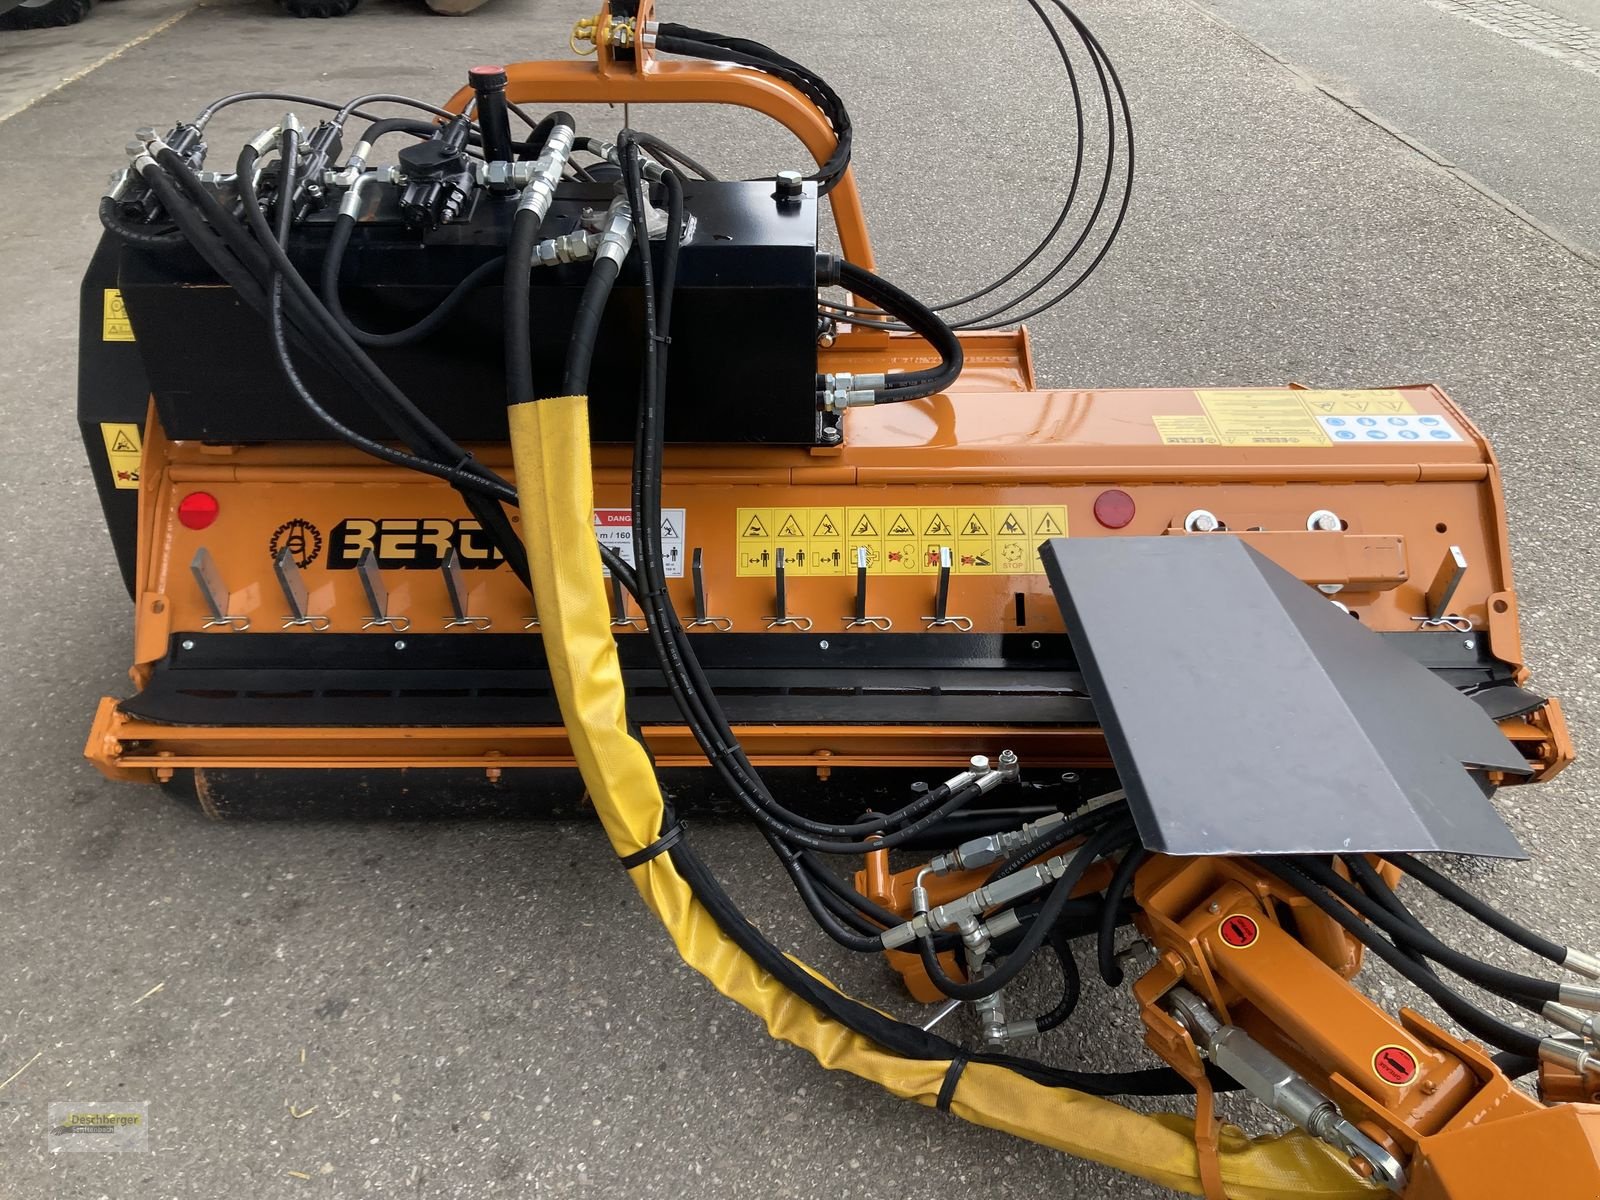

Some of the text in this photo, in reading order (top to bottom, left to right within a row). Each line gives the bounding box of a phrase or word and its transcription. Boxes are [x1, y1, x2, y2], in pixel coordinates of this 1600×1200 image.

[341, 519, 504, 560] BERT
[616, 531, 631, 539] 160
[1378, 1061, 1402, 1081] GREASE
